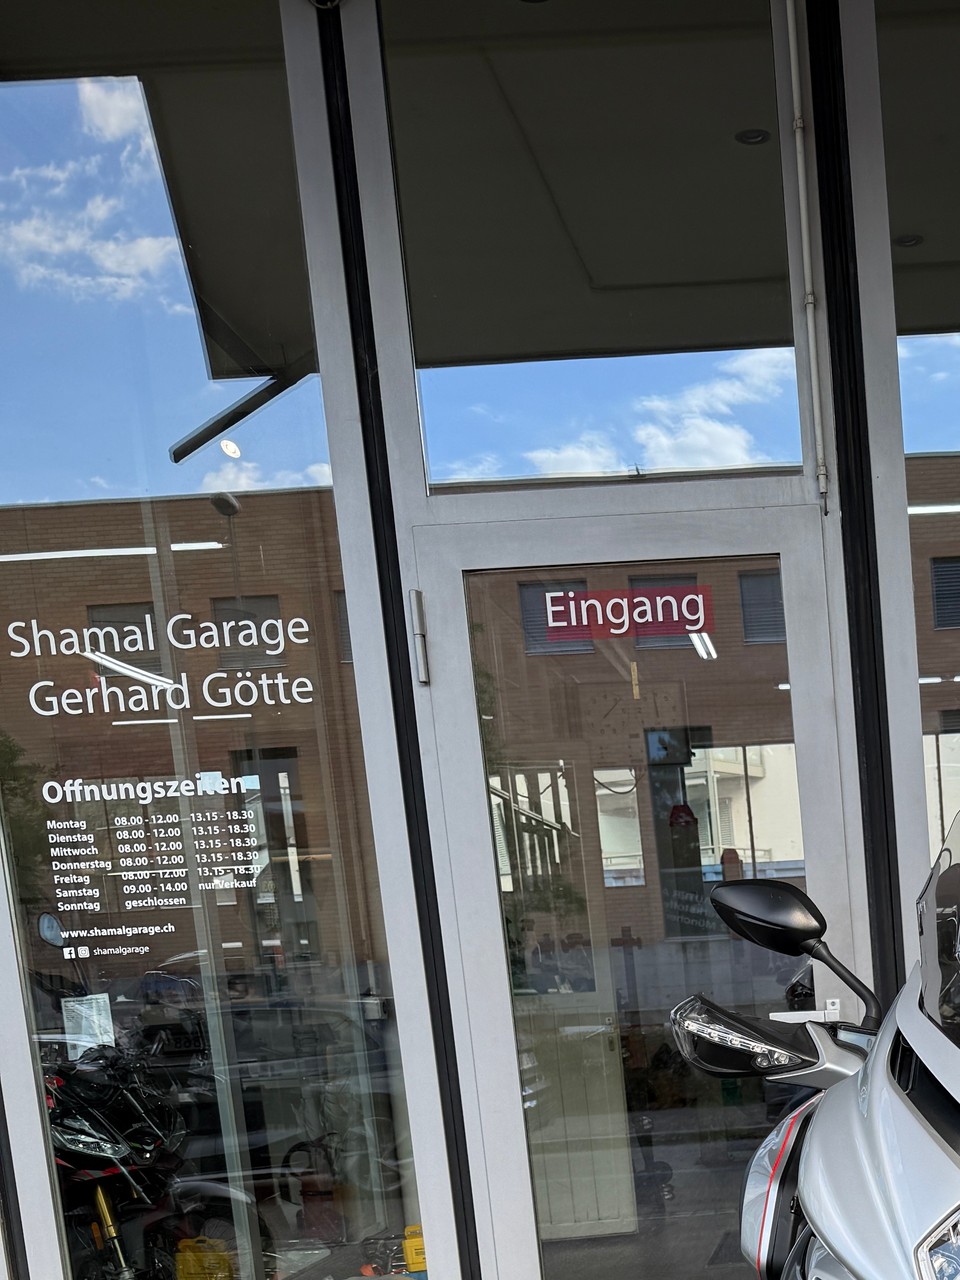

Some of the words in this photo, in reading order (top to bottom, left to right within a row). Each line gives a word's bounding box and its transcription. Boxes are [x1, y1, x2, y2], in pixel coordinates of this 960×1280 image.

[545, 590, 705, 634] Eingang
[7, 613, 155, 657] Shamal
[167, 614, 310, 655] Garage
[28, 673, 191, 717] Gerhard
[202, 672, 314, 708] Götte
[46, 820, 87, 830] Montag
[114, 816, 143, 826] 08.00
[150, 814, 179, 824] 12.00
[190, 812, 218, 821] 13.15
[226, 810, 254, 820] 18.30
[48, 833, 94, 843] Dienstag
[116, 830, 145, 840] 08.00
[153, 828, 180, 838] 12.00
[192, 826, 220, 836] 13.15
[228, 824, 256, 834] 18.30
[50, 845, 98, 857] Mittwoch
[118, 843, 146, 853] 08.00
[154, 842, 182, 851] 12.00
[194, 840, 221, 850] 13.15
[229, 837, 257, 848] 18.30
[52, 860, 112, 870] Donnerstag
[120, 857, 148, 867] 08.00
[156, 855, 184, 865] 12.00
[195, 853, 223, 863] 13.15
[231, 851, 259, 861] 18.30
[53, 874, 90, 884] Freitag
[121, 871, 150, 880] 08.00
[159, 870, 186, 879] 12.00
[197, 867, 225, 876] 13.15
[233, 866, 260, 875] 18.30
[55, 887, 100, 898] Samstag
[123, 884, 152, 894] 09.00
[160, 882, 188, 892] 14.00
[198, 882, 215, 890] nur
[218, 878, 257, 889] Verkauf
[57, 901, 101, 912] Sonntag
[125, 897, 186, 910] geschlossen
[60, 923, 175, 939] www.shamalgarage.ch
[93, 945, 150, 956] shamalgarage
